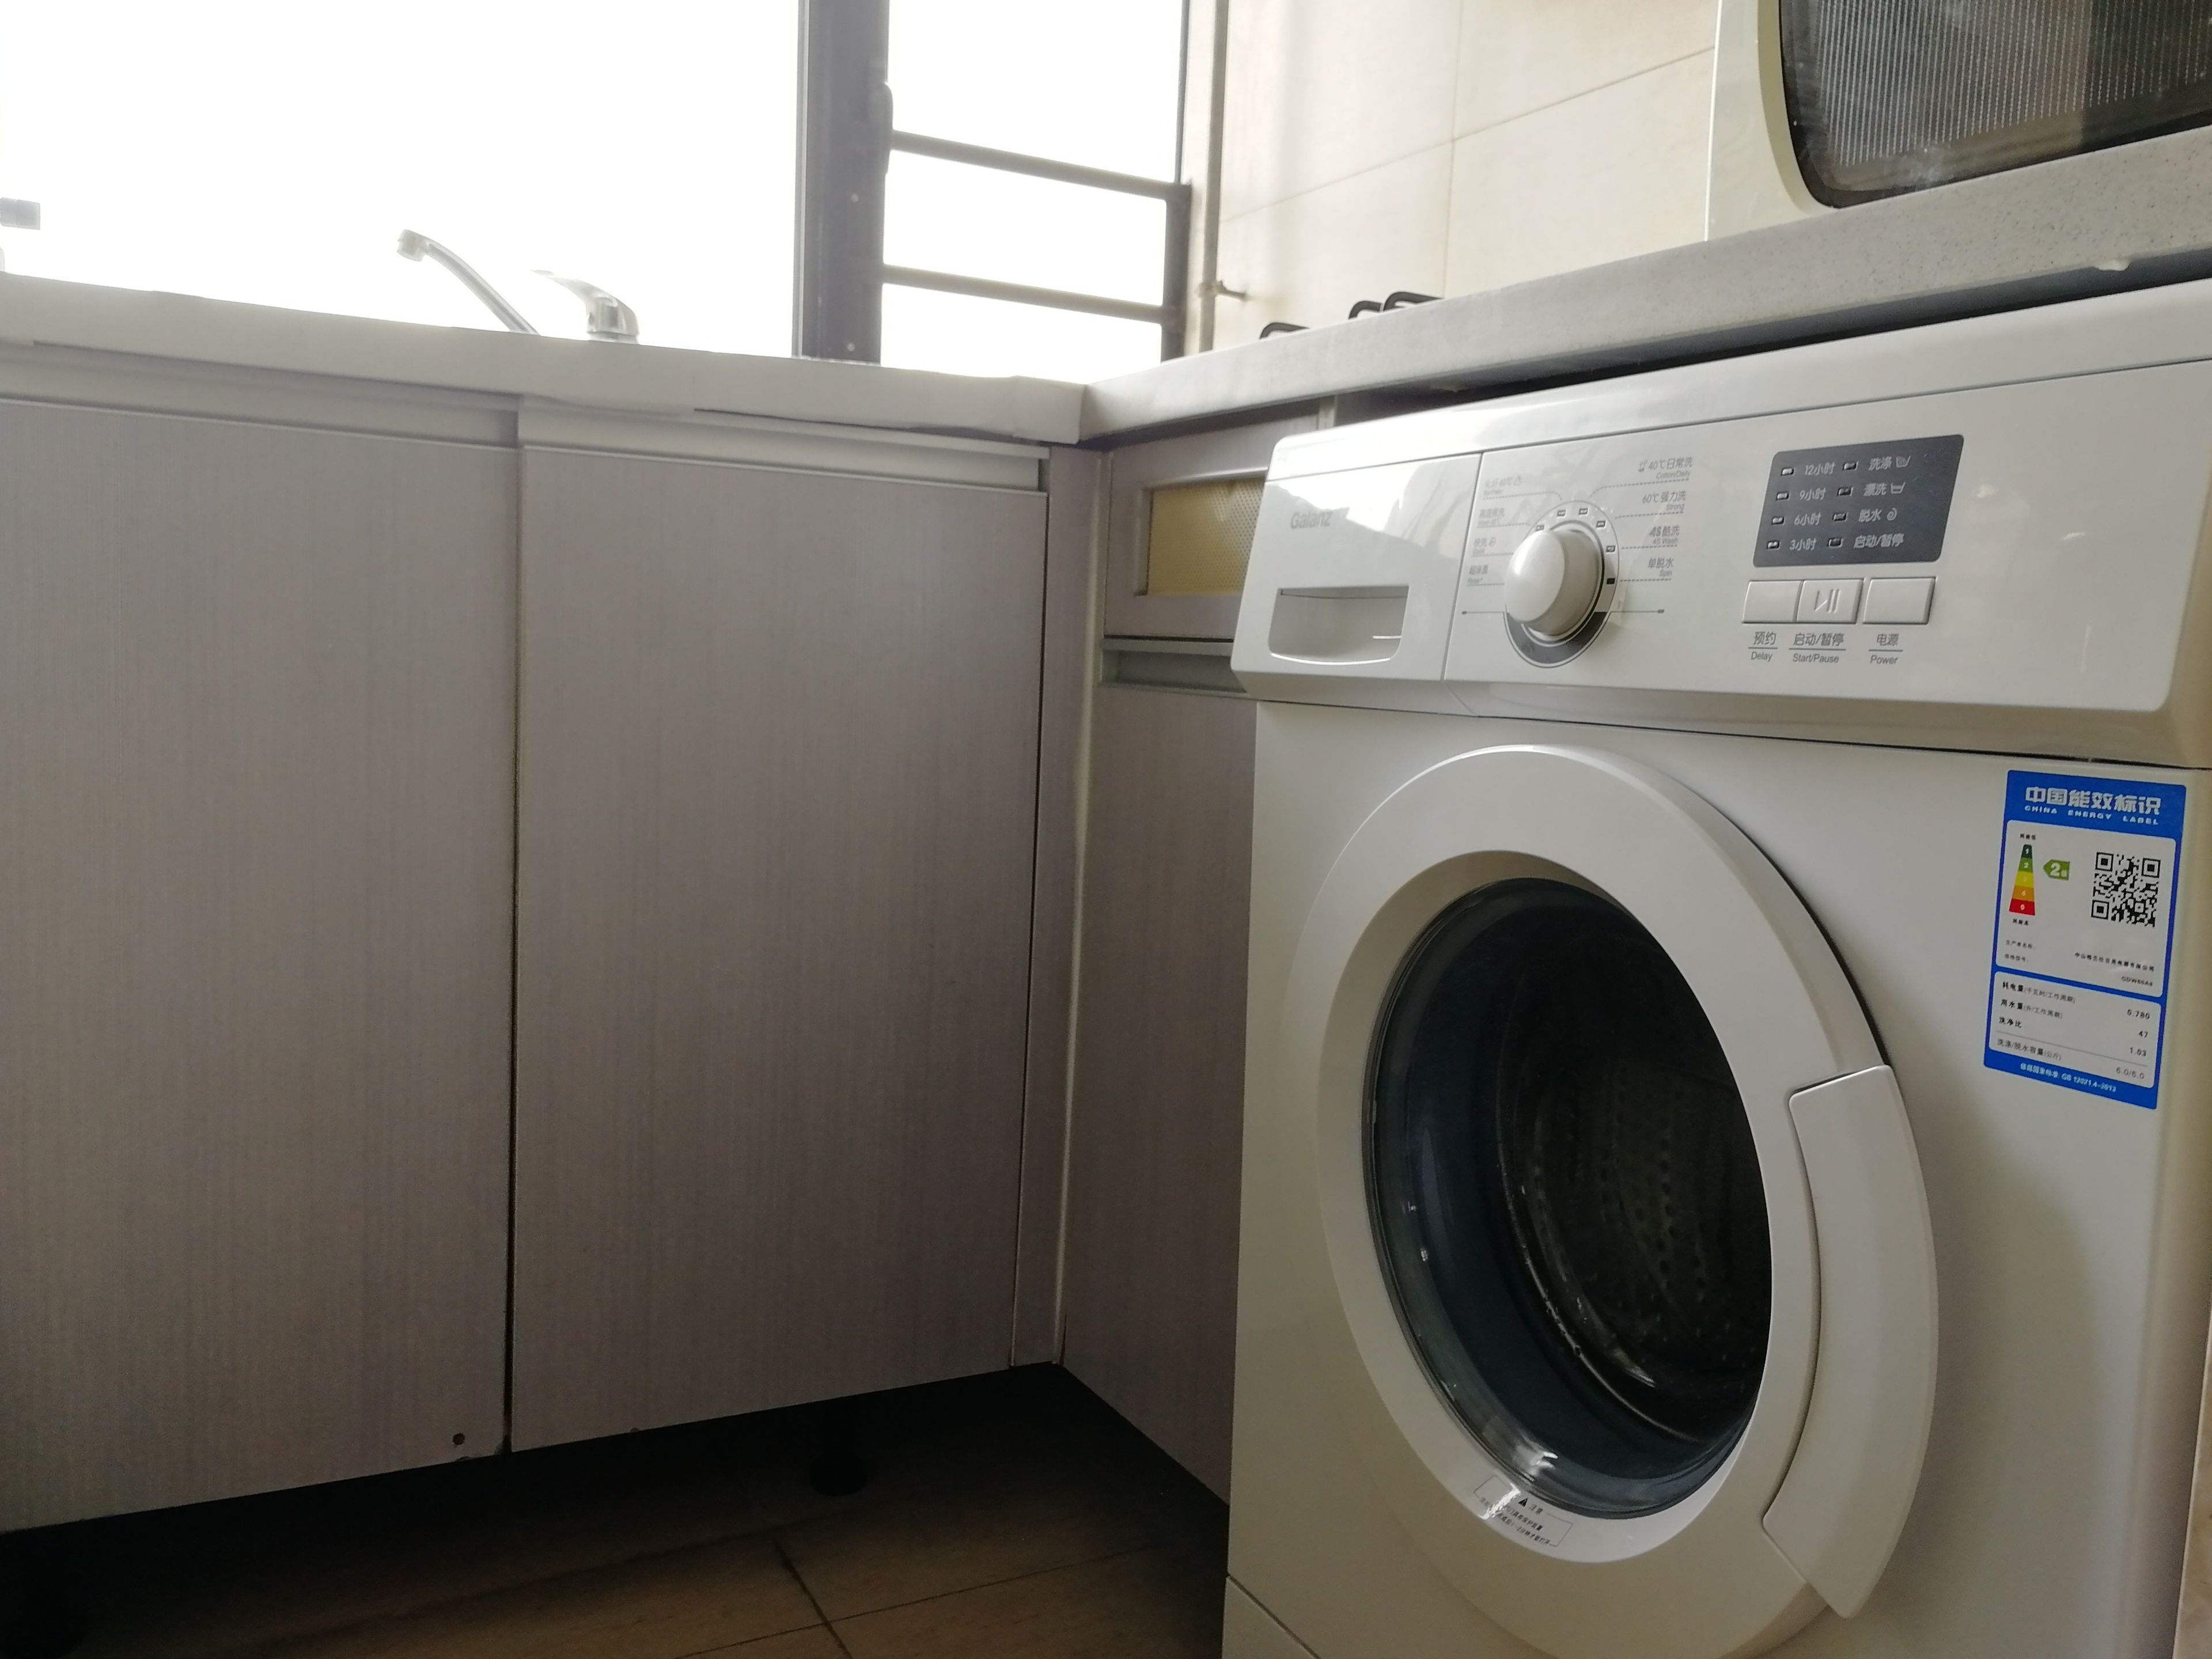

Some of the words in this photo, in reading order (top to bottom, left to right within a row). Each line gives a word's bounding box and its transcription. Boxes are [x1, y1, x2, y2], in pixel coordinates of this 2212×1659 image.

[1805, 463, 1835, 476] 12小时
[1869, 456, 1892, 471] 洗涤
[1800, 487, 1826, 501] 9小时
[1863, 483, 1888, 497] 漂洗
[1290, 511, 1333, 529] Galanz
[1794, 513, 1821, 527] 6小时
[1858, 509, 1881, 522] 脱水
[1789, 538, 1817, 551] 3小时
[1853, 533, 1904, 548] 启动/暂停
[1647, 557, 1674, 569] 单脱水
[1660, 570, 1673, 578] Spin
[1753, 631, 1777, 646] 预约
[1793, 633, 1844, 647] 启动/暂停
[1876, 633, 1899, 646] 电源
[1751, 652, 1773, 662] Delay
[1792, 653, 1839, 664] Start/Pause
[1870, 655, 1899, 665] Power
[2024, 786, 2162, 816] 中国能效标识
[2024, 805, 2058, 815] CHINA
[2067, 809, 2112, 820] ENERGY
[2123, 816, 2159, 825] LABEL
[2127, 1009, 2150, 1020] 0.780
[2130, 1047, 2147, 1057] 1.03
